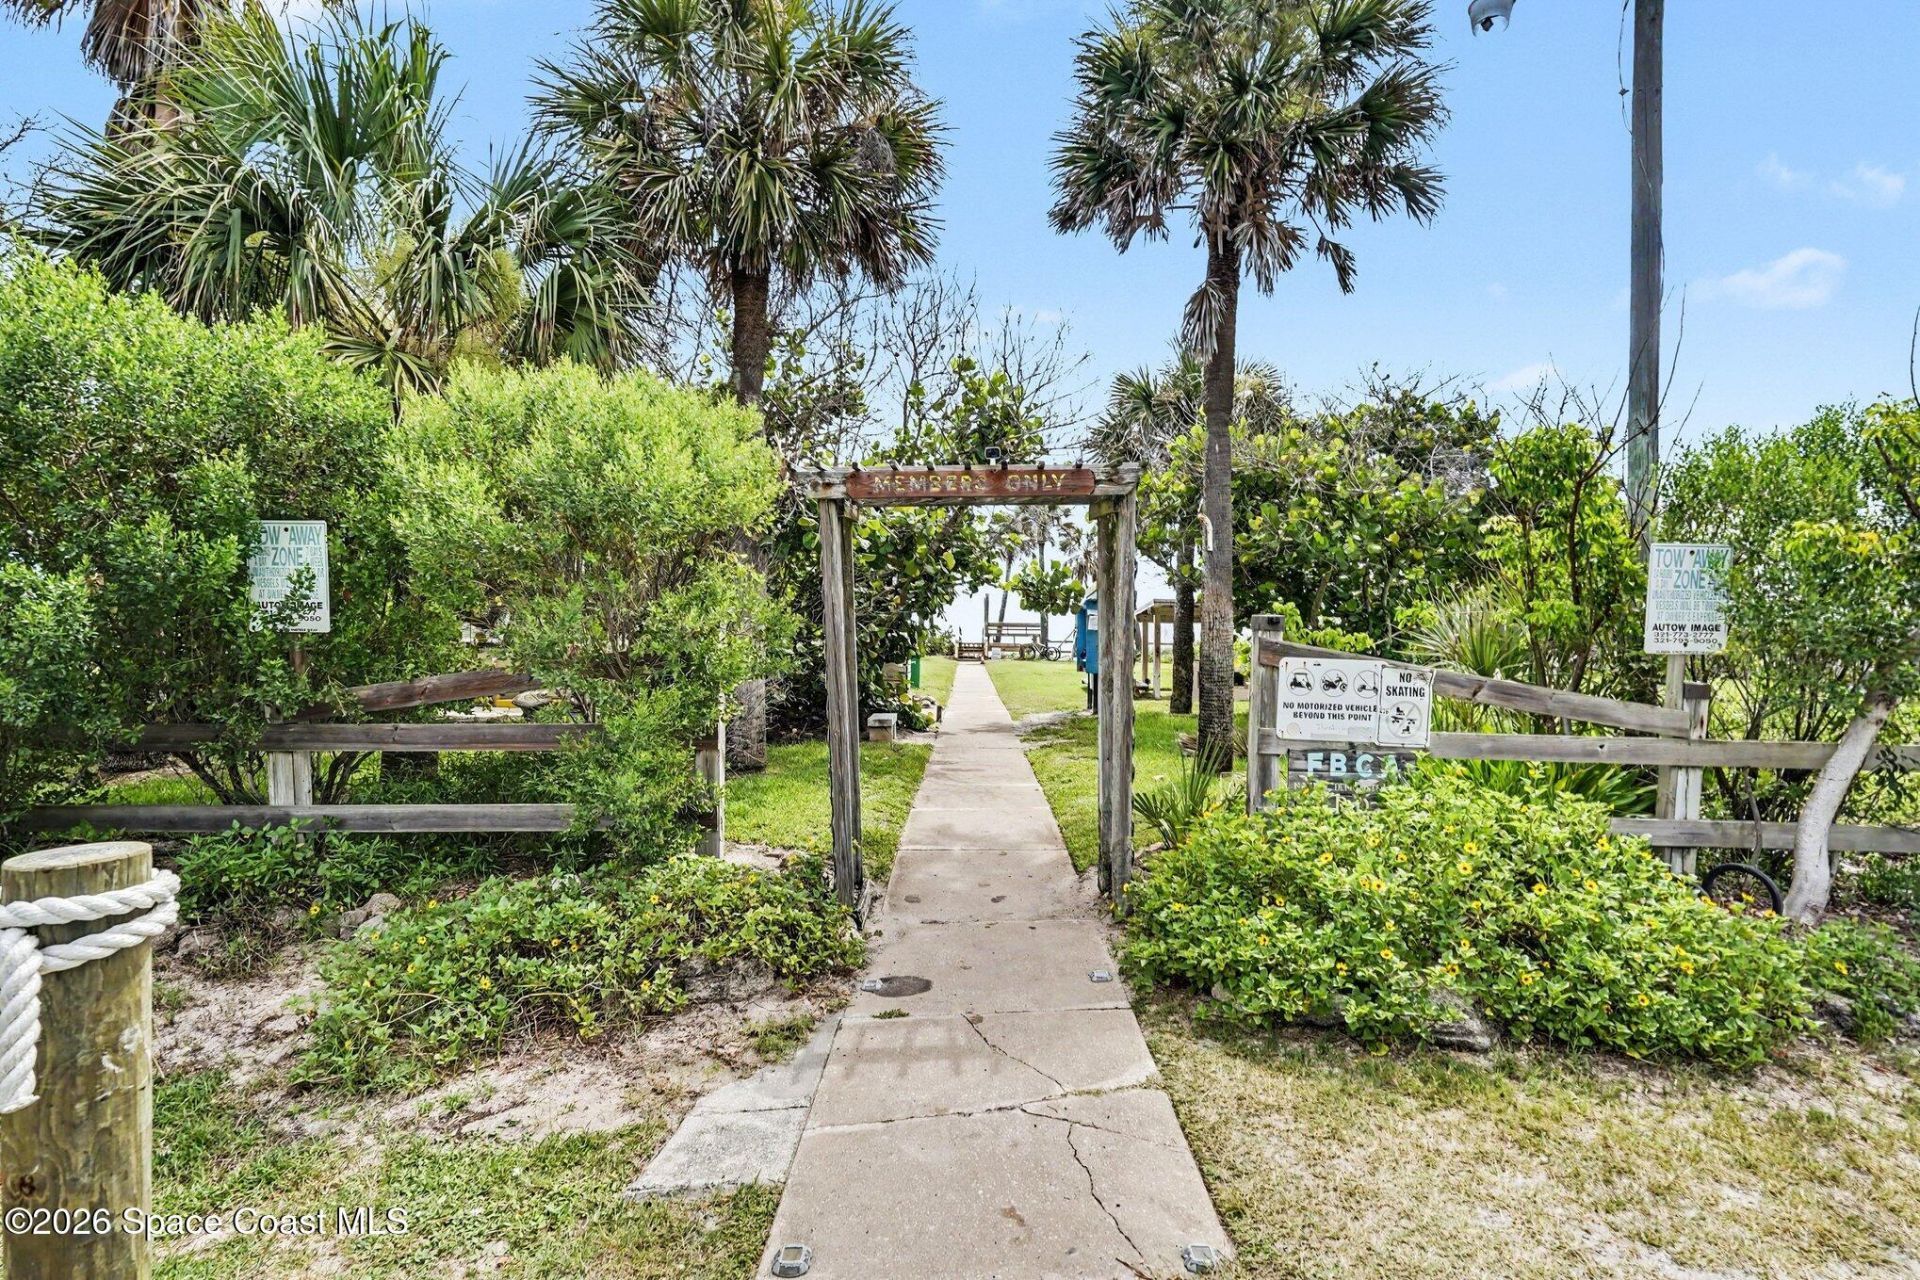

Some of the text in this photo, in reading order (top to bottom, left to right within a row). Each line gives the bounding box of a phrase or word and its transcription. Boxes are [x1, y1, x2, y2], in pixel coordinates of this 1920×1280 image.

[874, 473, 1066, 493] MEMBERS ONLY
[261, 526, 322, 545] OW AWAY
[271, 547, 303, 566] ZONE
[1655, 549, 1730, 568] TOW AWY
[1674, 570, 1706, 589] ZONE
[1652, 623, 1721, 632] AUTOW IMAGE
[1399, 672, 1412, 683] NO
[1385, 686, 1425, 698] SKATING
[1297, 702, 1343, 711] MOTORIZED
[1293, 711, 1372, 721] BEYOND THIS POINT
